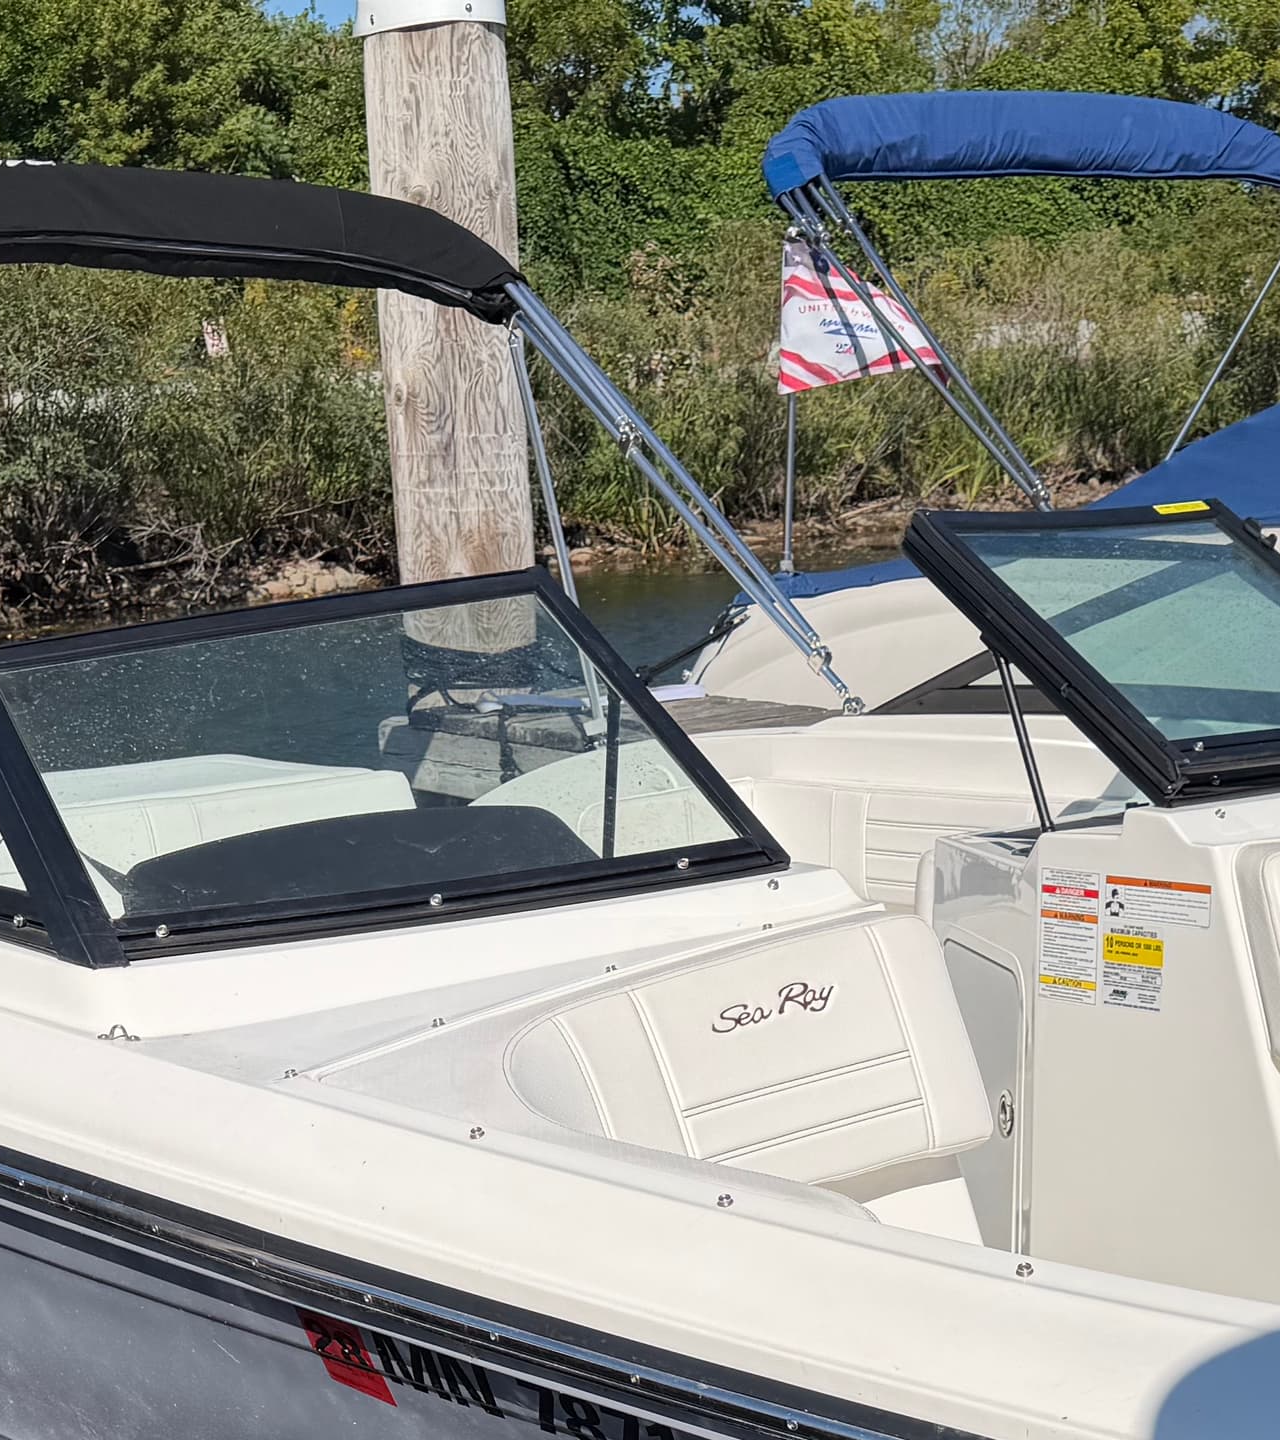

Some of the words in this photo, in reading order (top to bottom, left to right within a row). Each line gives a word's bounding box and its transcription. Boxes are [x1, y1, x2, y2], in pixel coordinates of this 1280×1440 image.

[712, 1004, 772, 1033] Sea
[778, 982, 834, 1015] Ray
[371, 1331, 505, 1419] MN
